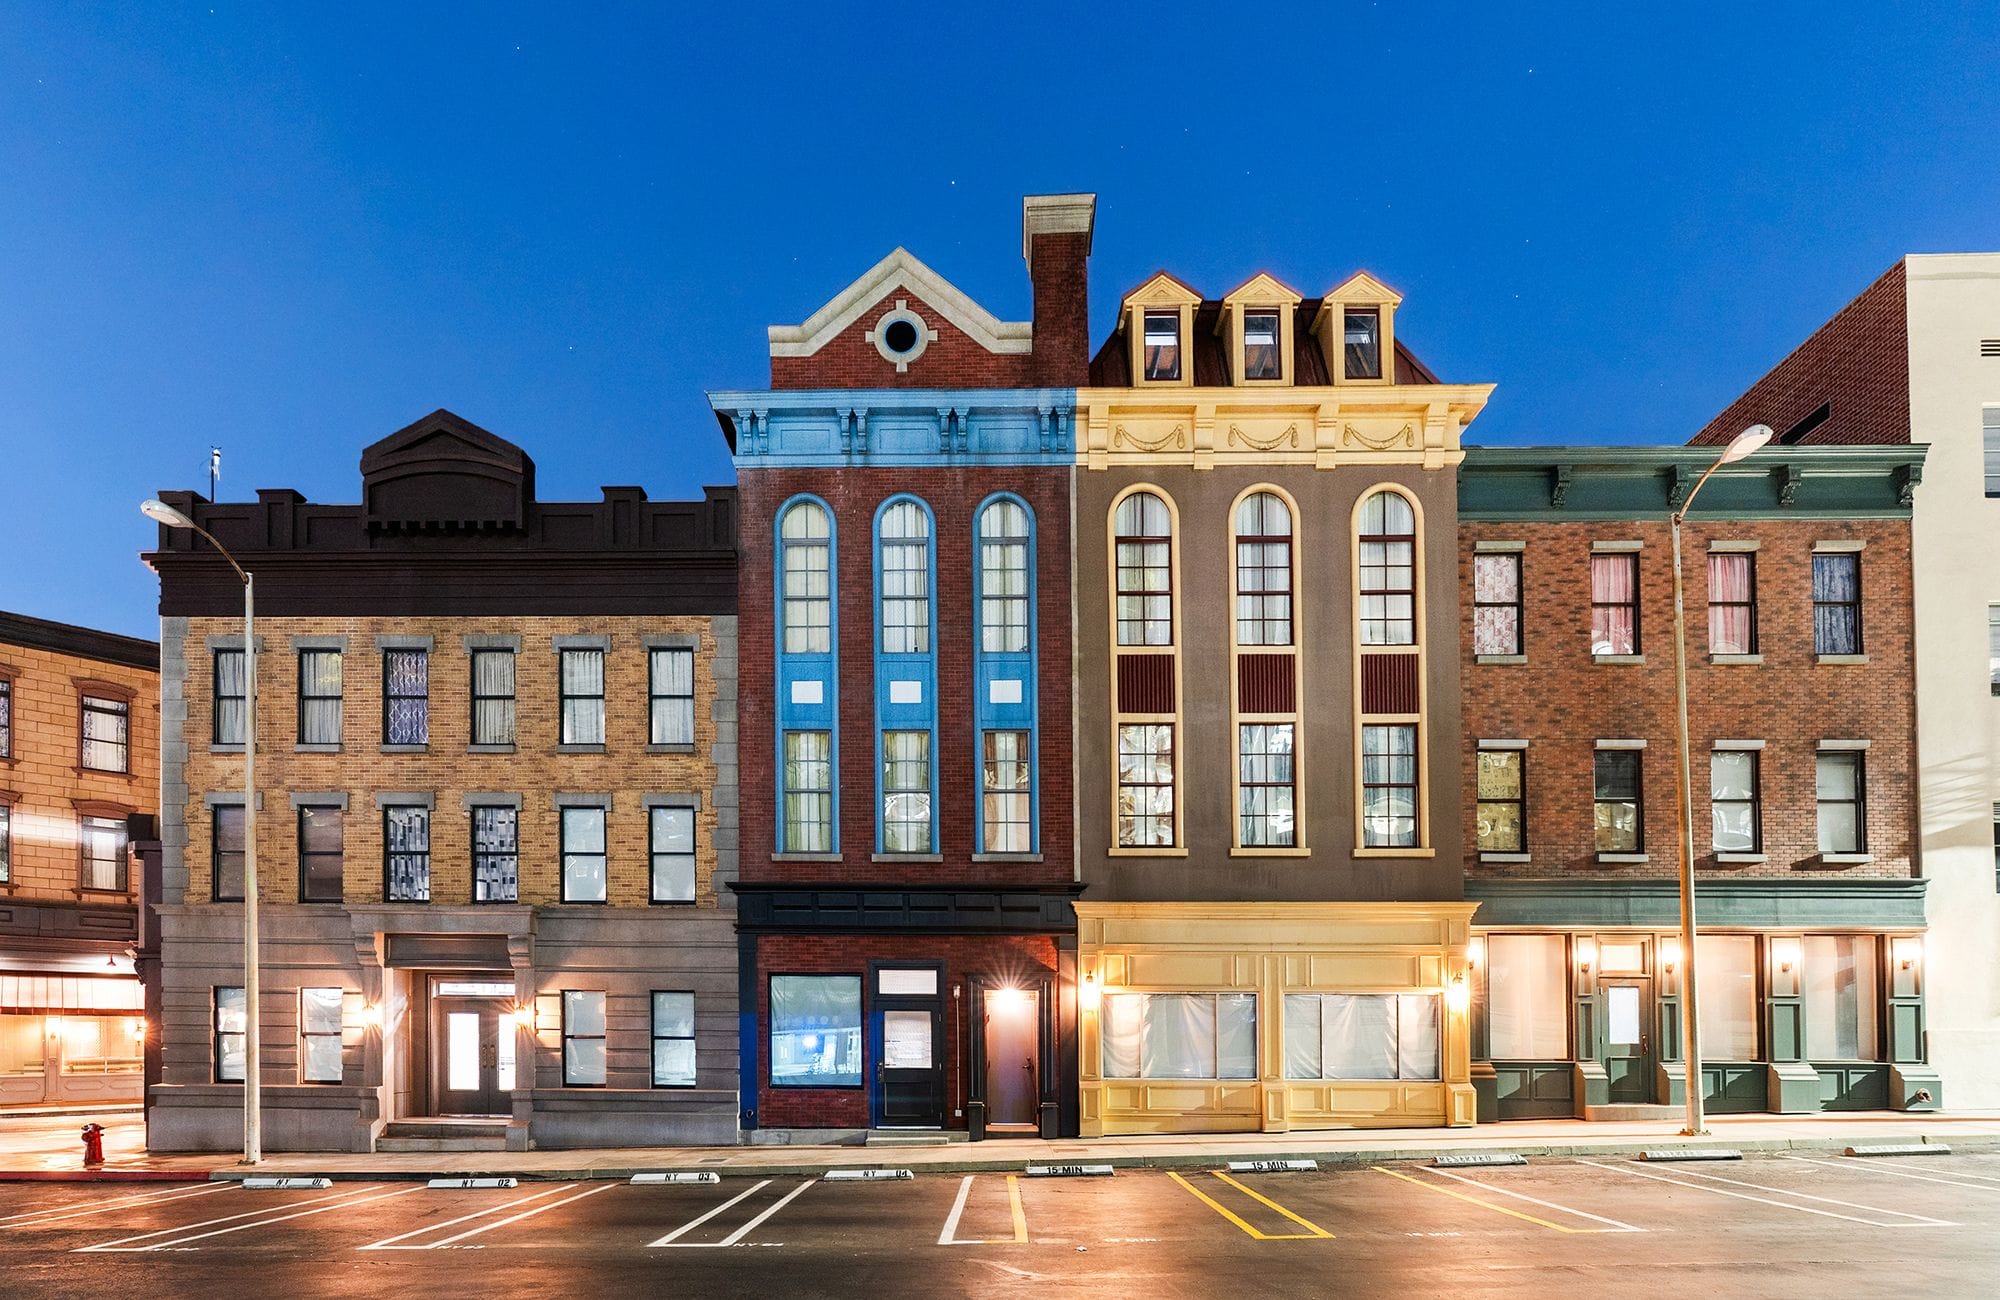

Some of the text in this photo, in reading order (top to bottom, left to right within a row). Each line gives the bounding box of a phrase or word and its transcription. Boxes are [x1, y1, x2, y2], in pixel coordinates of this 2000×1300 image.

[1252, 1161, 1288, 1170] 15 MIN
[1062, 1166, 1083, 1174] MIN
[698, 1173, 711, 1181] 03
[497, 1179, 511, 1187] 02
